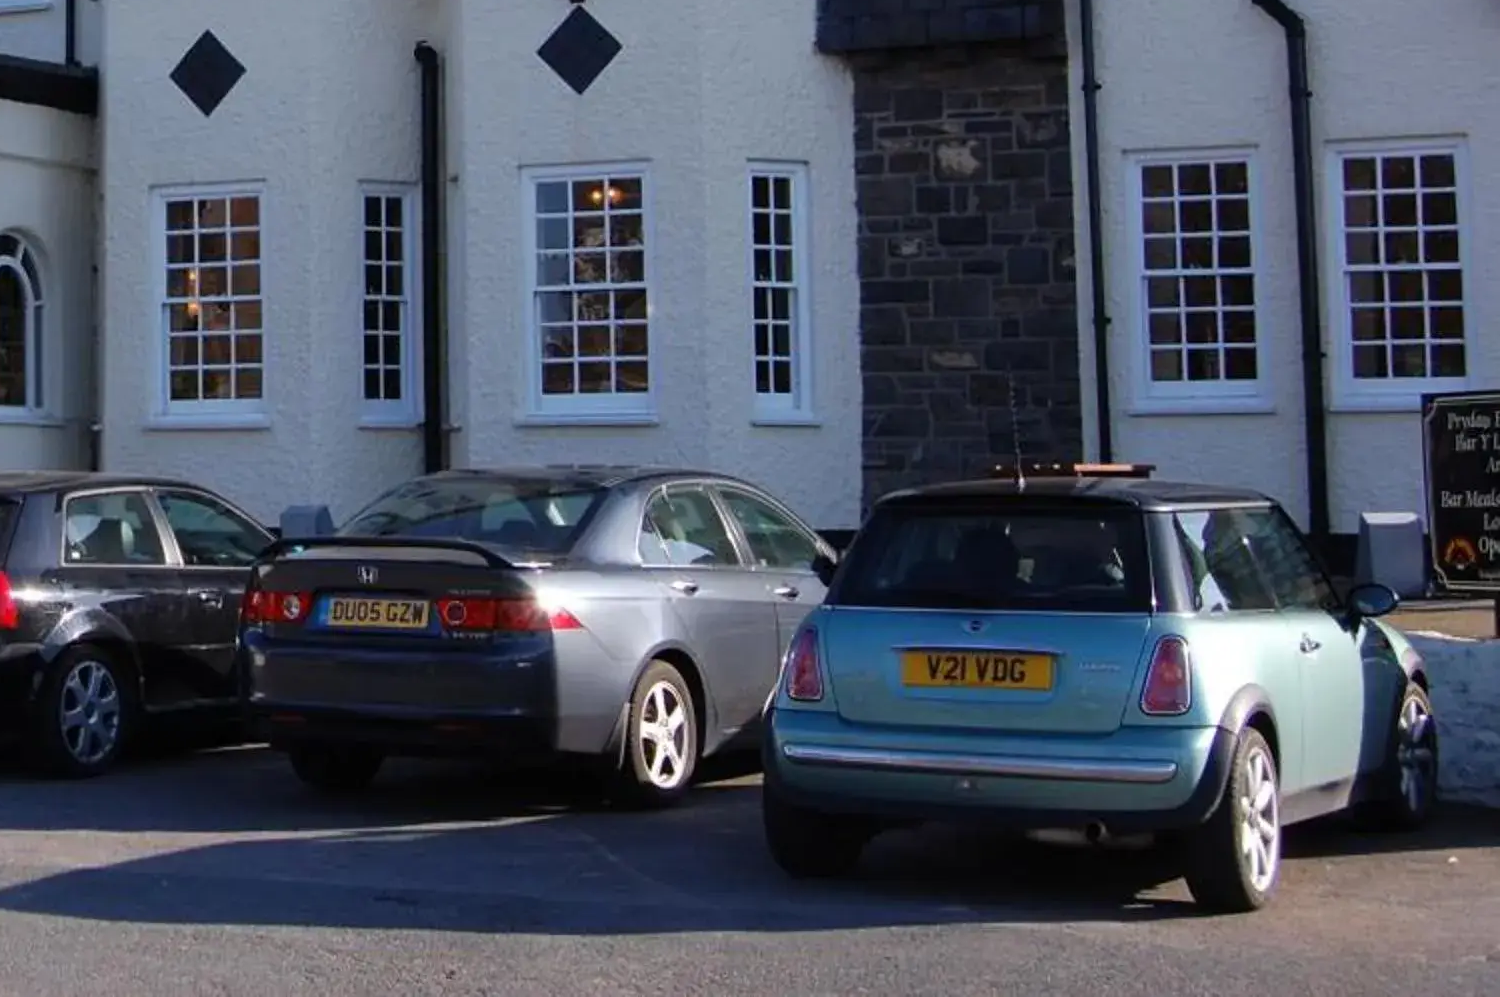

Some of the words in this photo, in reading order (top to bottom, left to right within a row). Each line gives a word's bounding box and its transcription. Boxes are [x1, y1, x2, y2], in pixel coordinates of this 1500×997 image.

[1441, 490, 1464, 508] Bar
[331, 600, 381, 623] DU05
[386, 601, 425, 625] GZW
[927, 654, 967, 681] V21
[975, 656, 1027, 684] VDG
